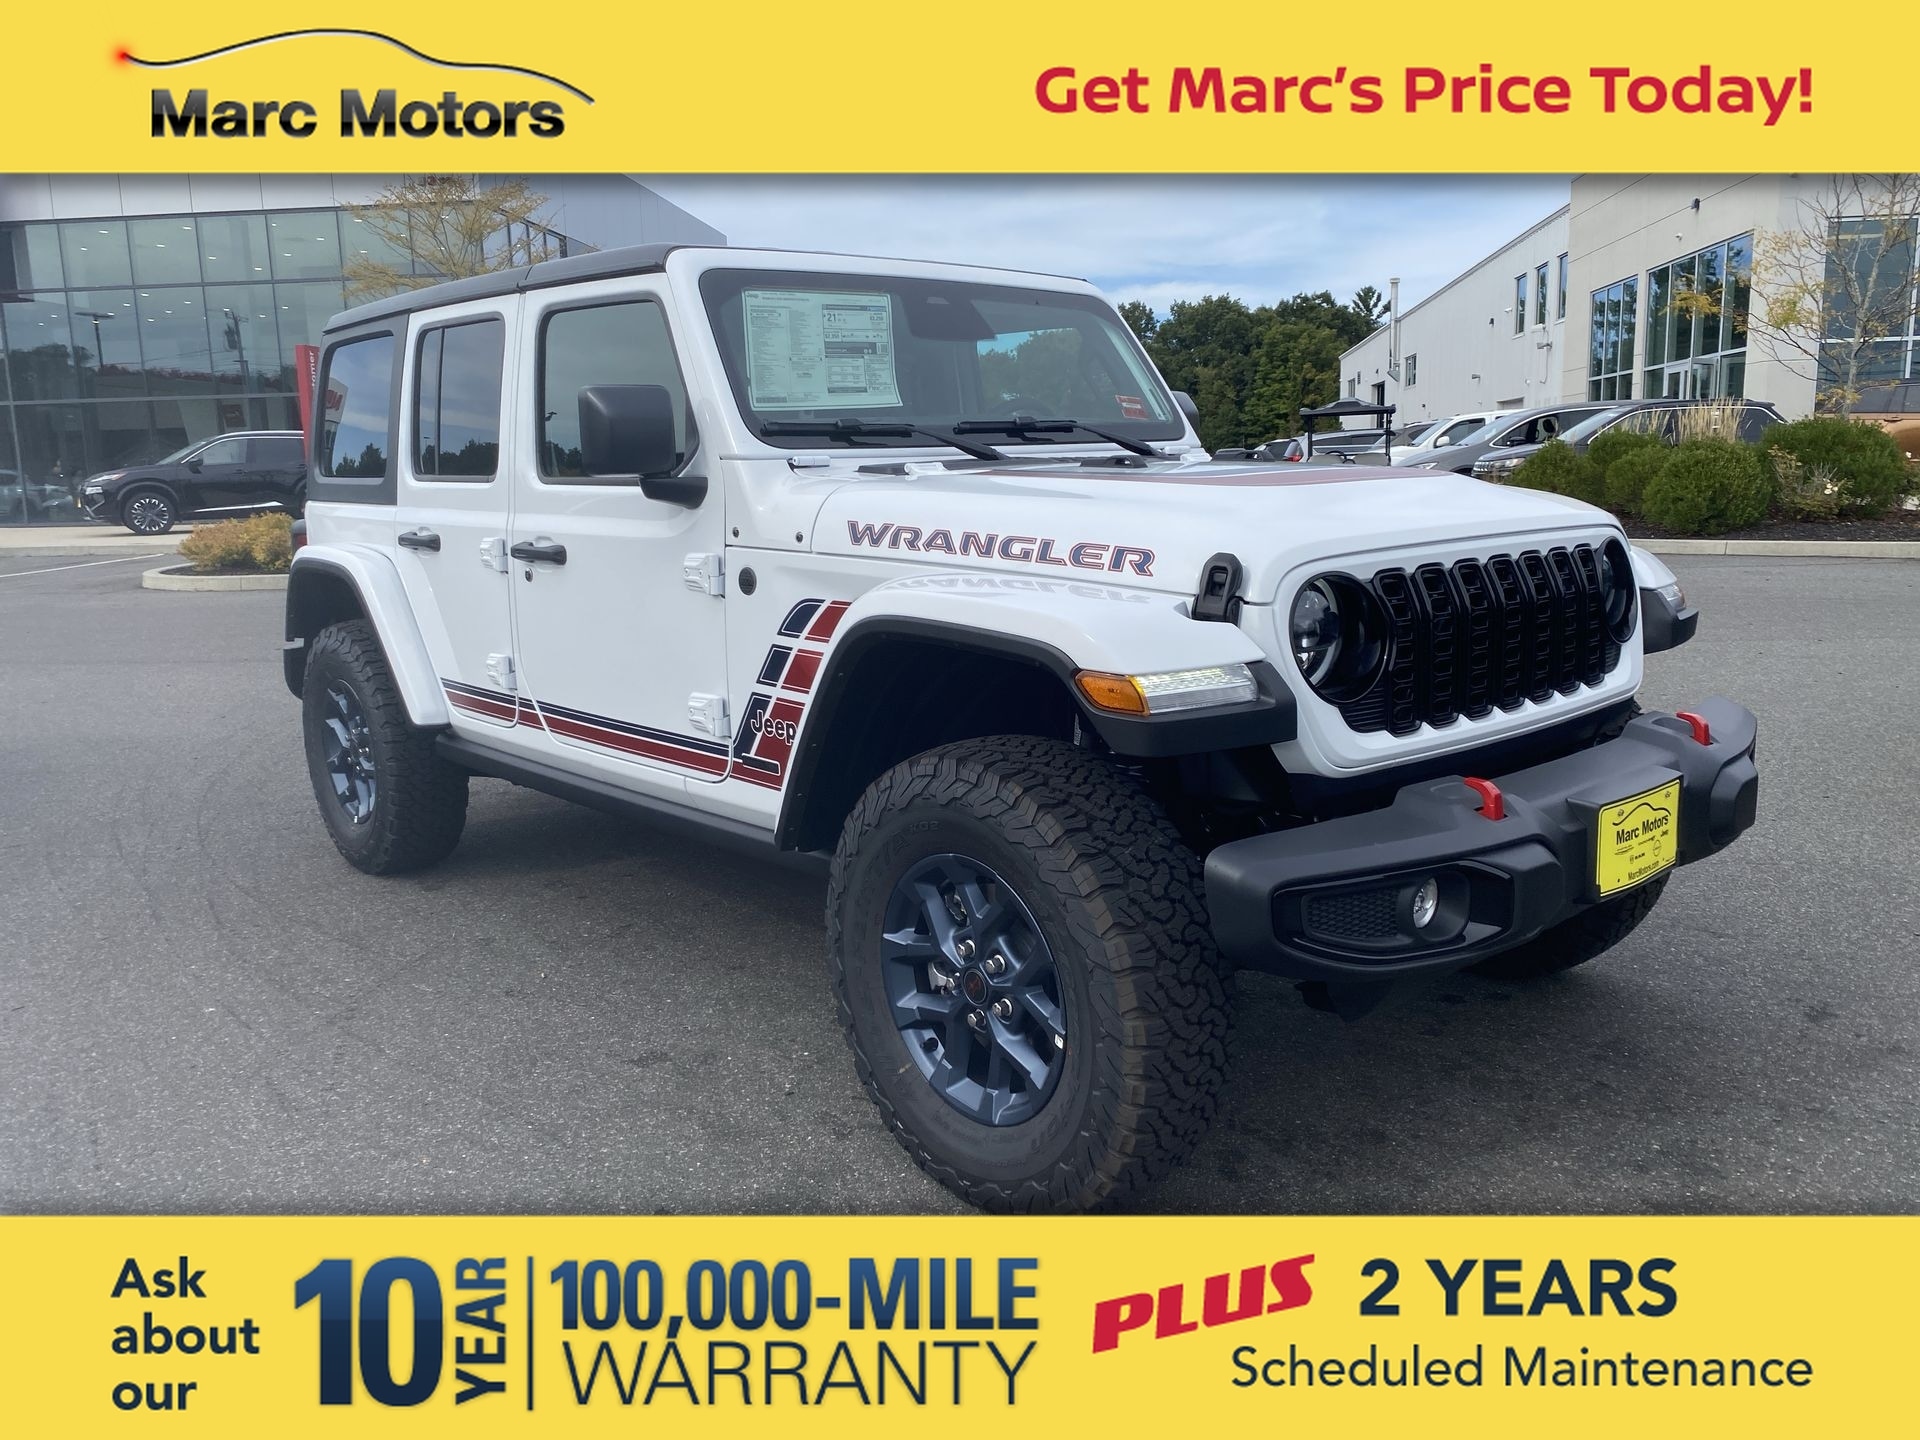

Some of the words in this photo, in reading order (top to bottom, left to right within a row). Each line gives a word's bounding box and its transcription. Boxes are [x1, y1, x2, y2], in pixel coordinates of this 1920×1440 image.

[847, 520, 1155, 577] WRANGLER
[750, 709, 798, 745] Jeep
[1616, 828, 1640, 846] Marc
[1642, 814, 1669, 836] Motors
